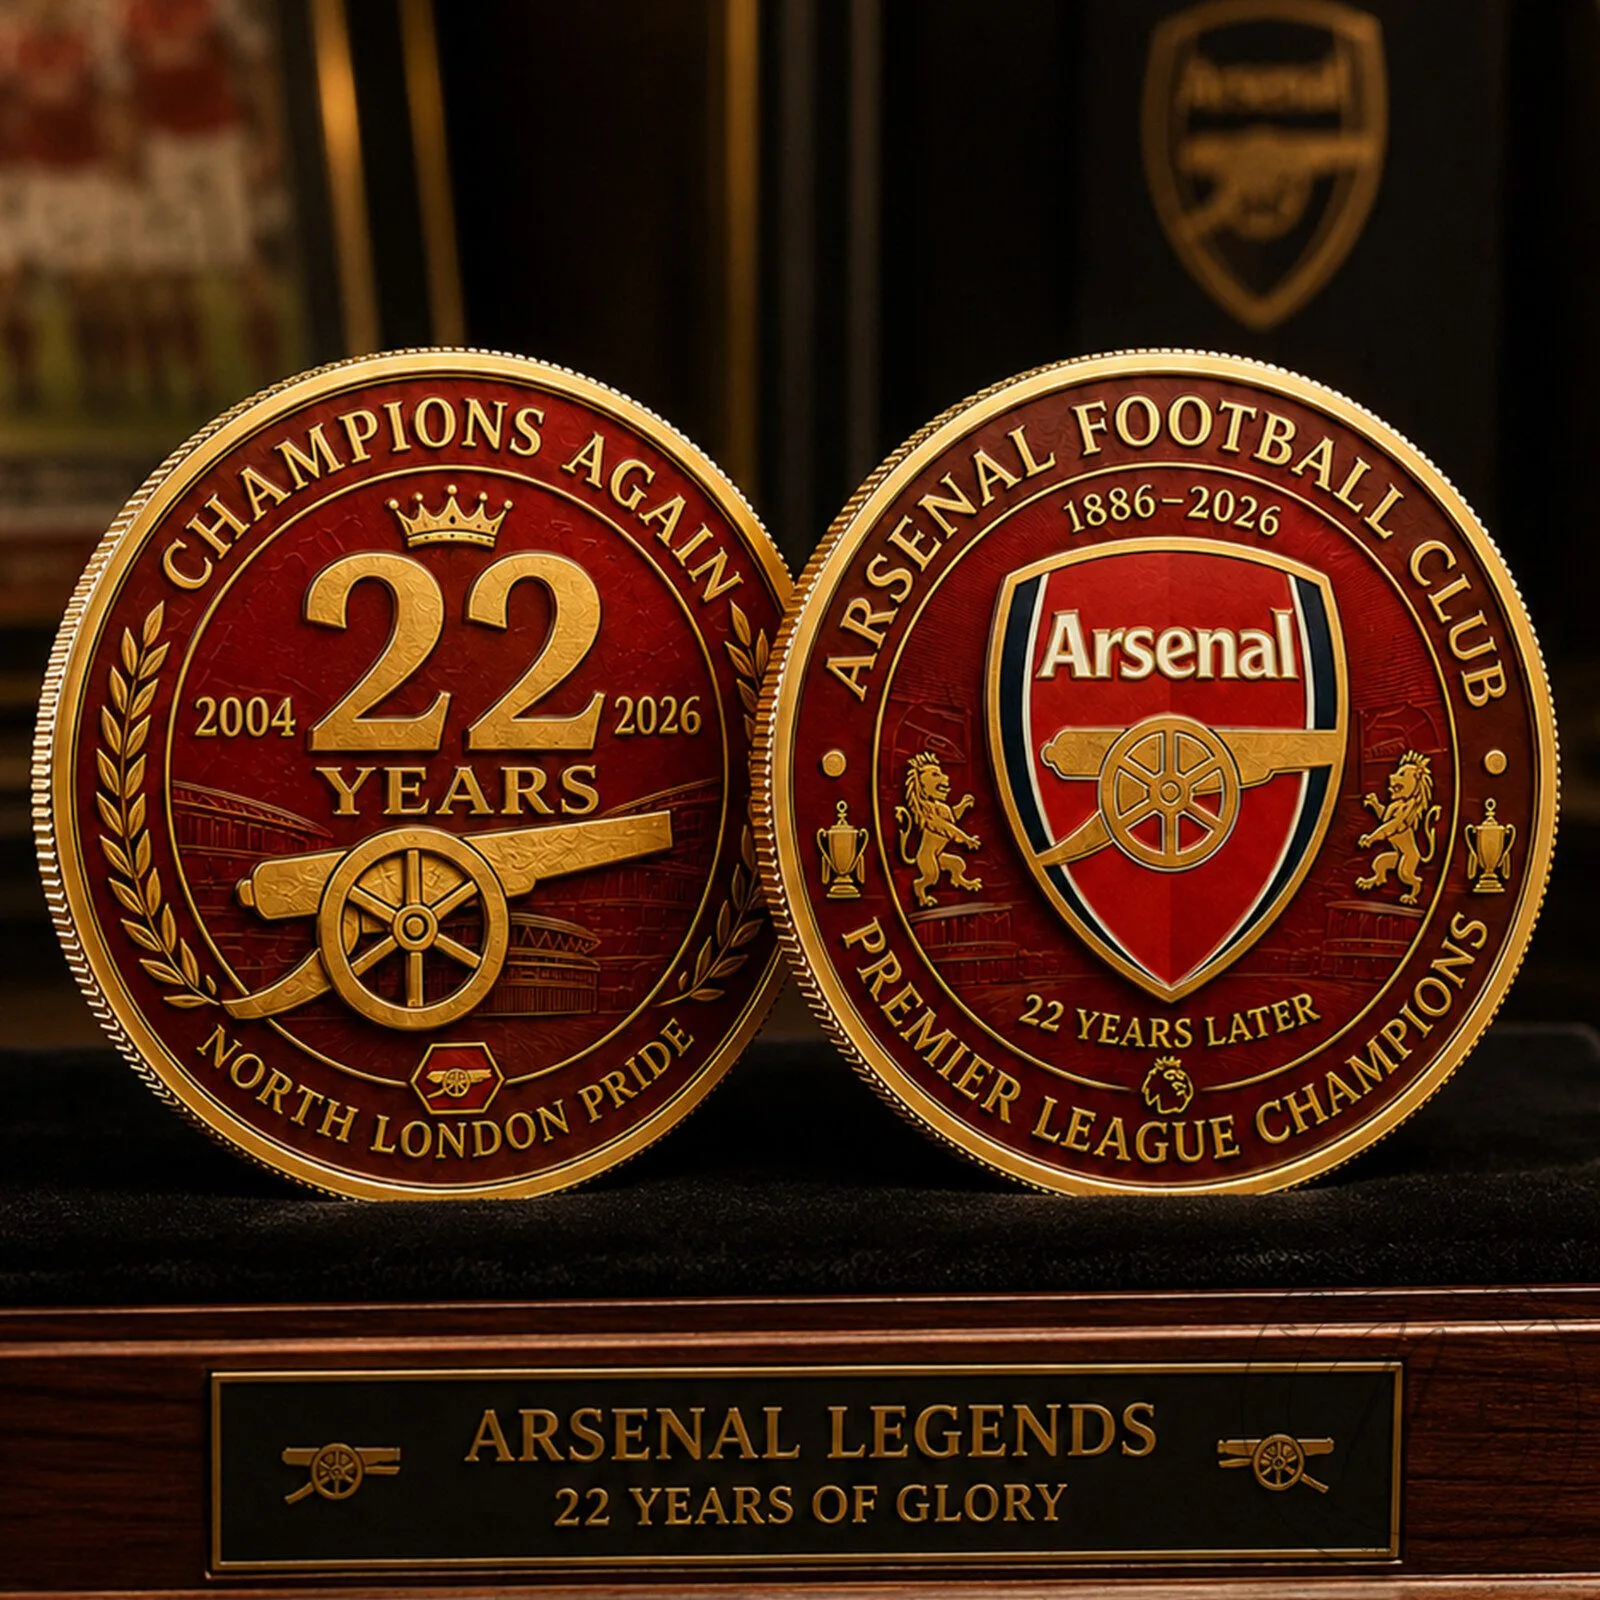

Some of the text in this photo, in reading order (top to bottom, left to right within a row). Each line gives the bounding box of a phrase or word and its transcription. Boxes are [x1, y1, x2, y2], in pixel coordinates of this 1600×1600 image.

[161, 396, 743, 602] CHAMPIONS AGAIN
[826, 395, 1508, 707] ARSENAL FOOTBALL CLUB
[305, 552, 605, 751] 22
[1036, 608, 1299, 681] Arsenal
[194, 697, 296, 738] 2004
[613, 694, 701, 736] 2026
[316, 765, 599, 815] YEARS
[842, 911, 1489, 1163] PREMIER LEAGUE CHAMPIONS
[1018, 992, 1321, 1049] 22 YEARS LATER
[196, 1017, 694, 1160] NORTH LONDON PRIDE
[464, 1401, 1158, 1463] ARSENAL LEGENDS
[553, 1482, 1067, 1527] 22 YEARS OF GLORY
